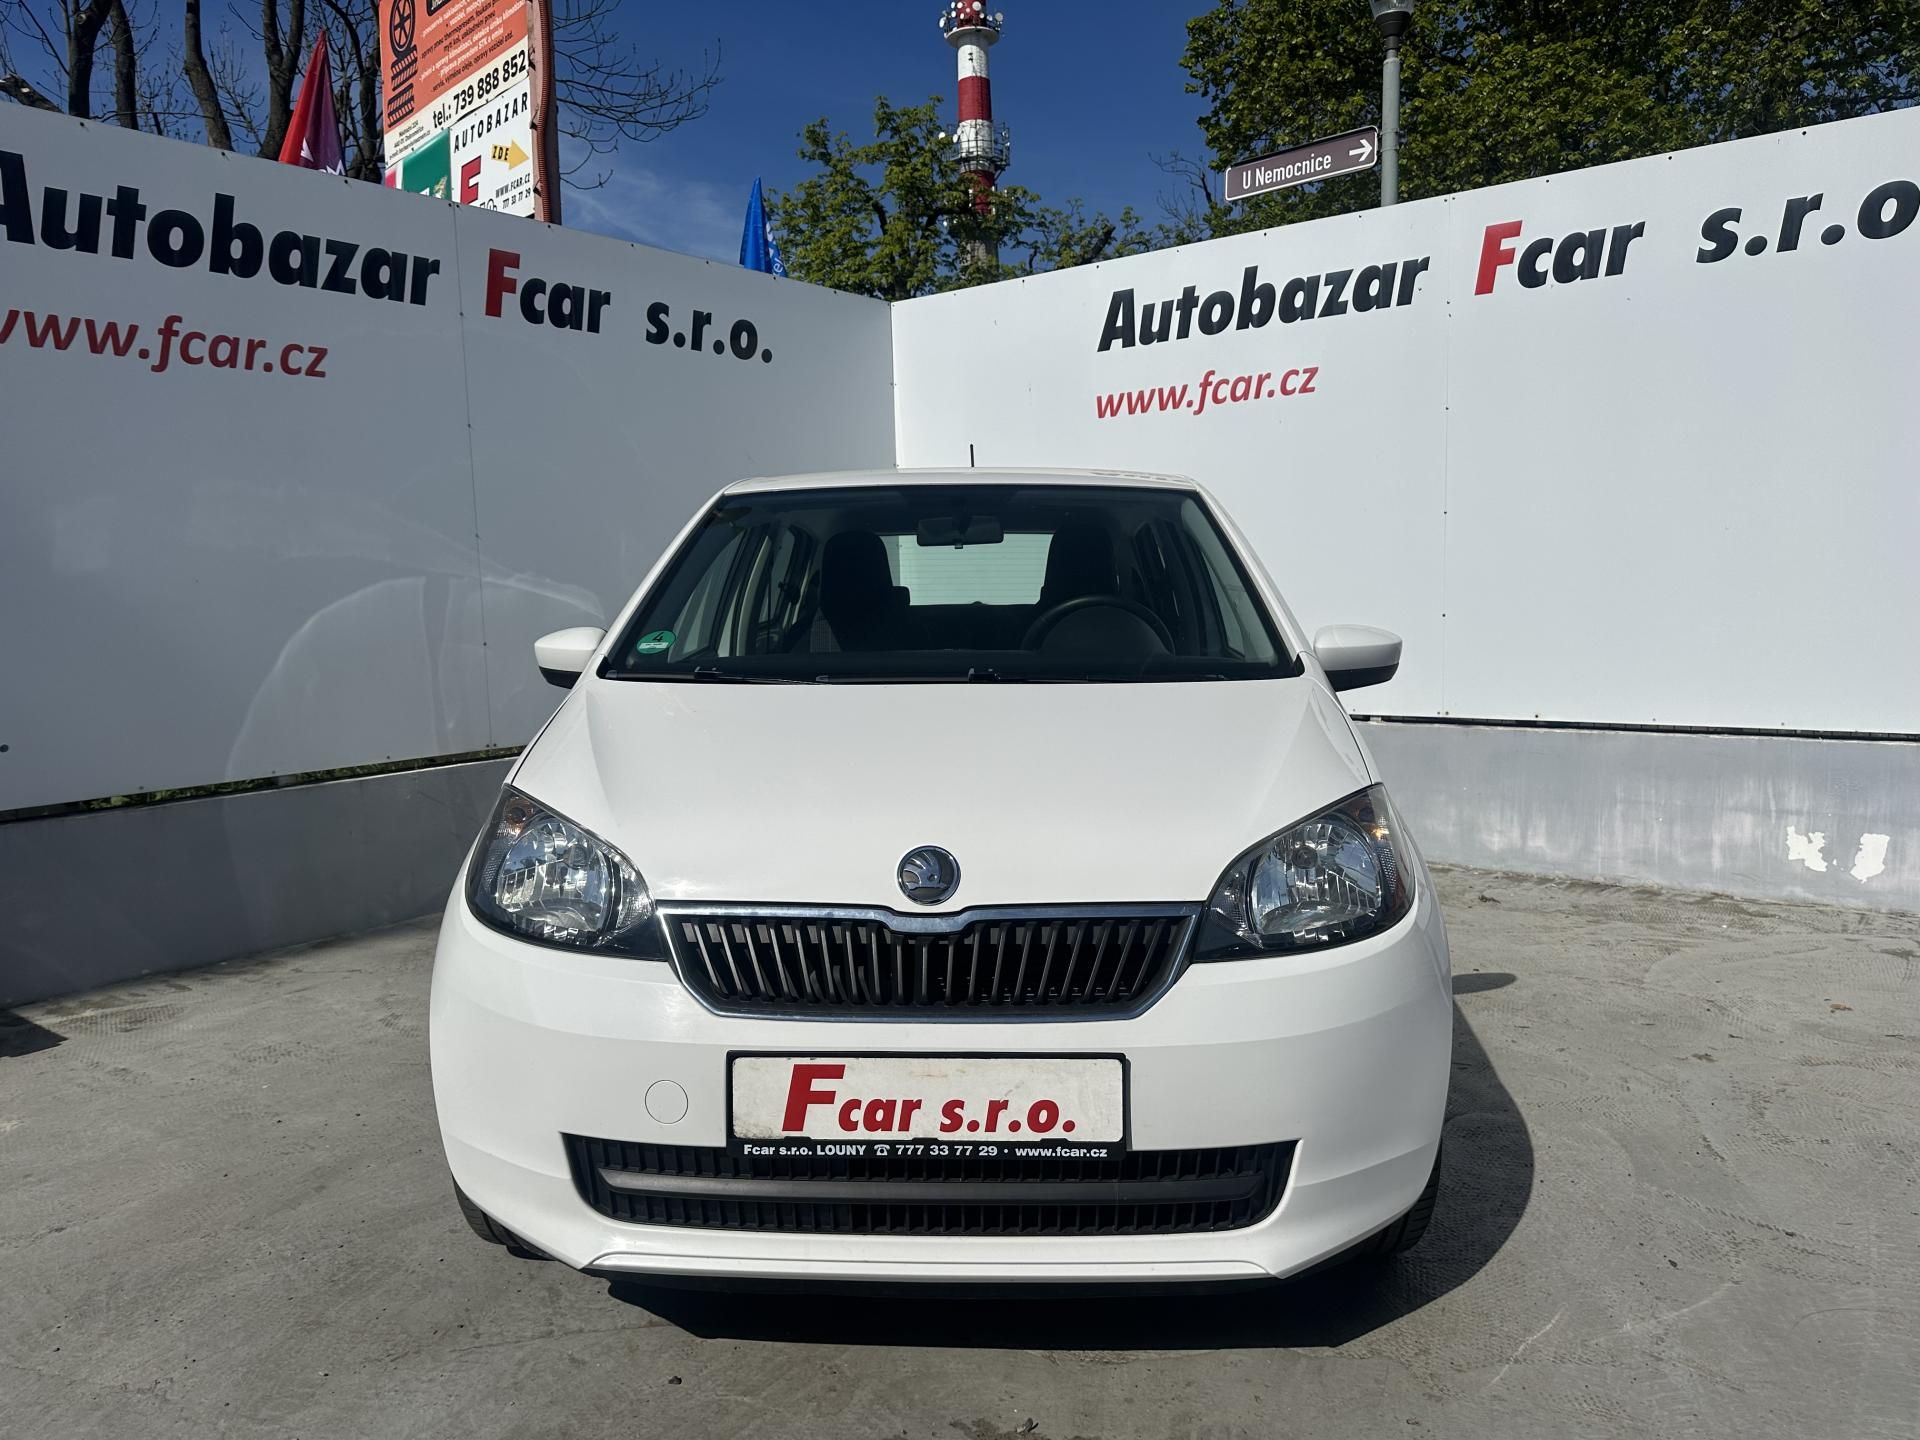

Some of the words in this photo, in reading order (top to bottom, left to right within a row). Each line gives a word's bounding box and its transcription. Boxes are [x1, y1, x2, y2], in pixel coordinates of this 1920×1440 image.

[433, 103, 452, 129] tel.:
[453, 85, 474, 114] 739
[477, 68, 500, 99] 888
[503, 50, 526, 83] 852
[454, 91, 528, 153] AUTOBAZAR
[492, 145, 509, 161] ZDE
[1242, 170, 1251, 189] U
[1255, 153, 1332, 187] Nemocnice
[495, 173, 530, 198] WWW.FCAR.CZ
[0, 150, 440, 306] Autobazar
[484, 248, 612, 335] Fcar
[645, 301, 774, 363] s.r.o.
[1097, 256, 1430, 352] Autobazar
[1474, 220, 1645, 296] Fcar
[1096, 366, 1319, 419] www.fcar.cz
[781, 1063, 922, 1133] Fcar
[939, 1098, 1076, 1133] s.r.o.
[743, 1144, 775, 1155] Fcar
[779, 1145, 812, 1155] s.r.o.
[817, 1145, 866, 1155] LOUNY
[896, 1145, 924, 1155] 777
[929, 1145, 949, 1155] 33
[954, 1146, 973, 1155] 77
[978, 1146, 998, 1156] 29
[1015, 1147, 1107, 1157] www.fcar.cz
